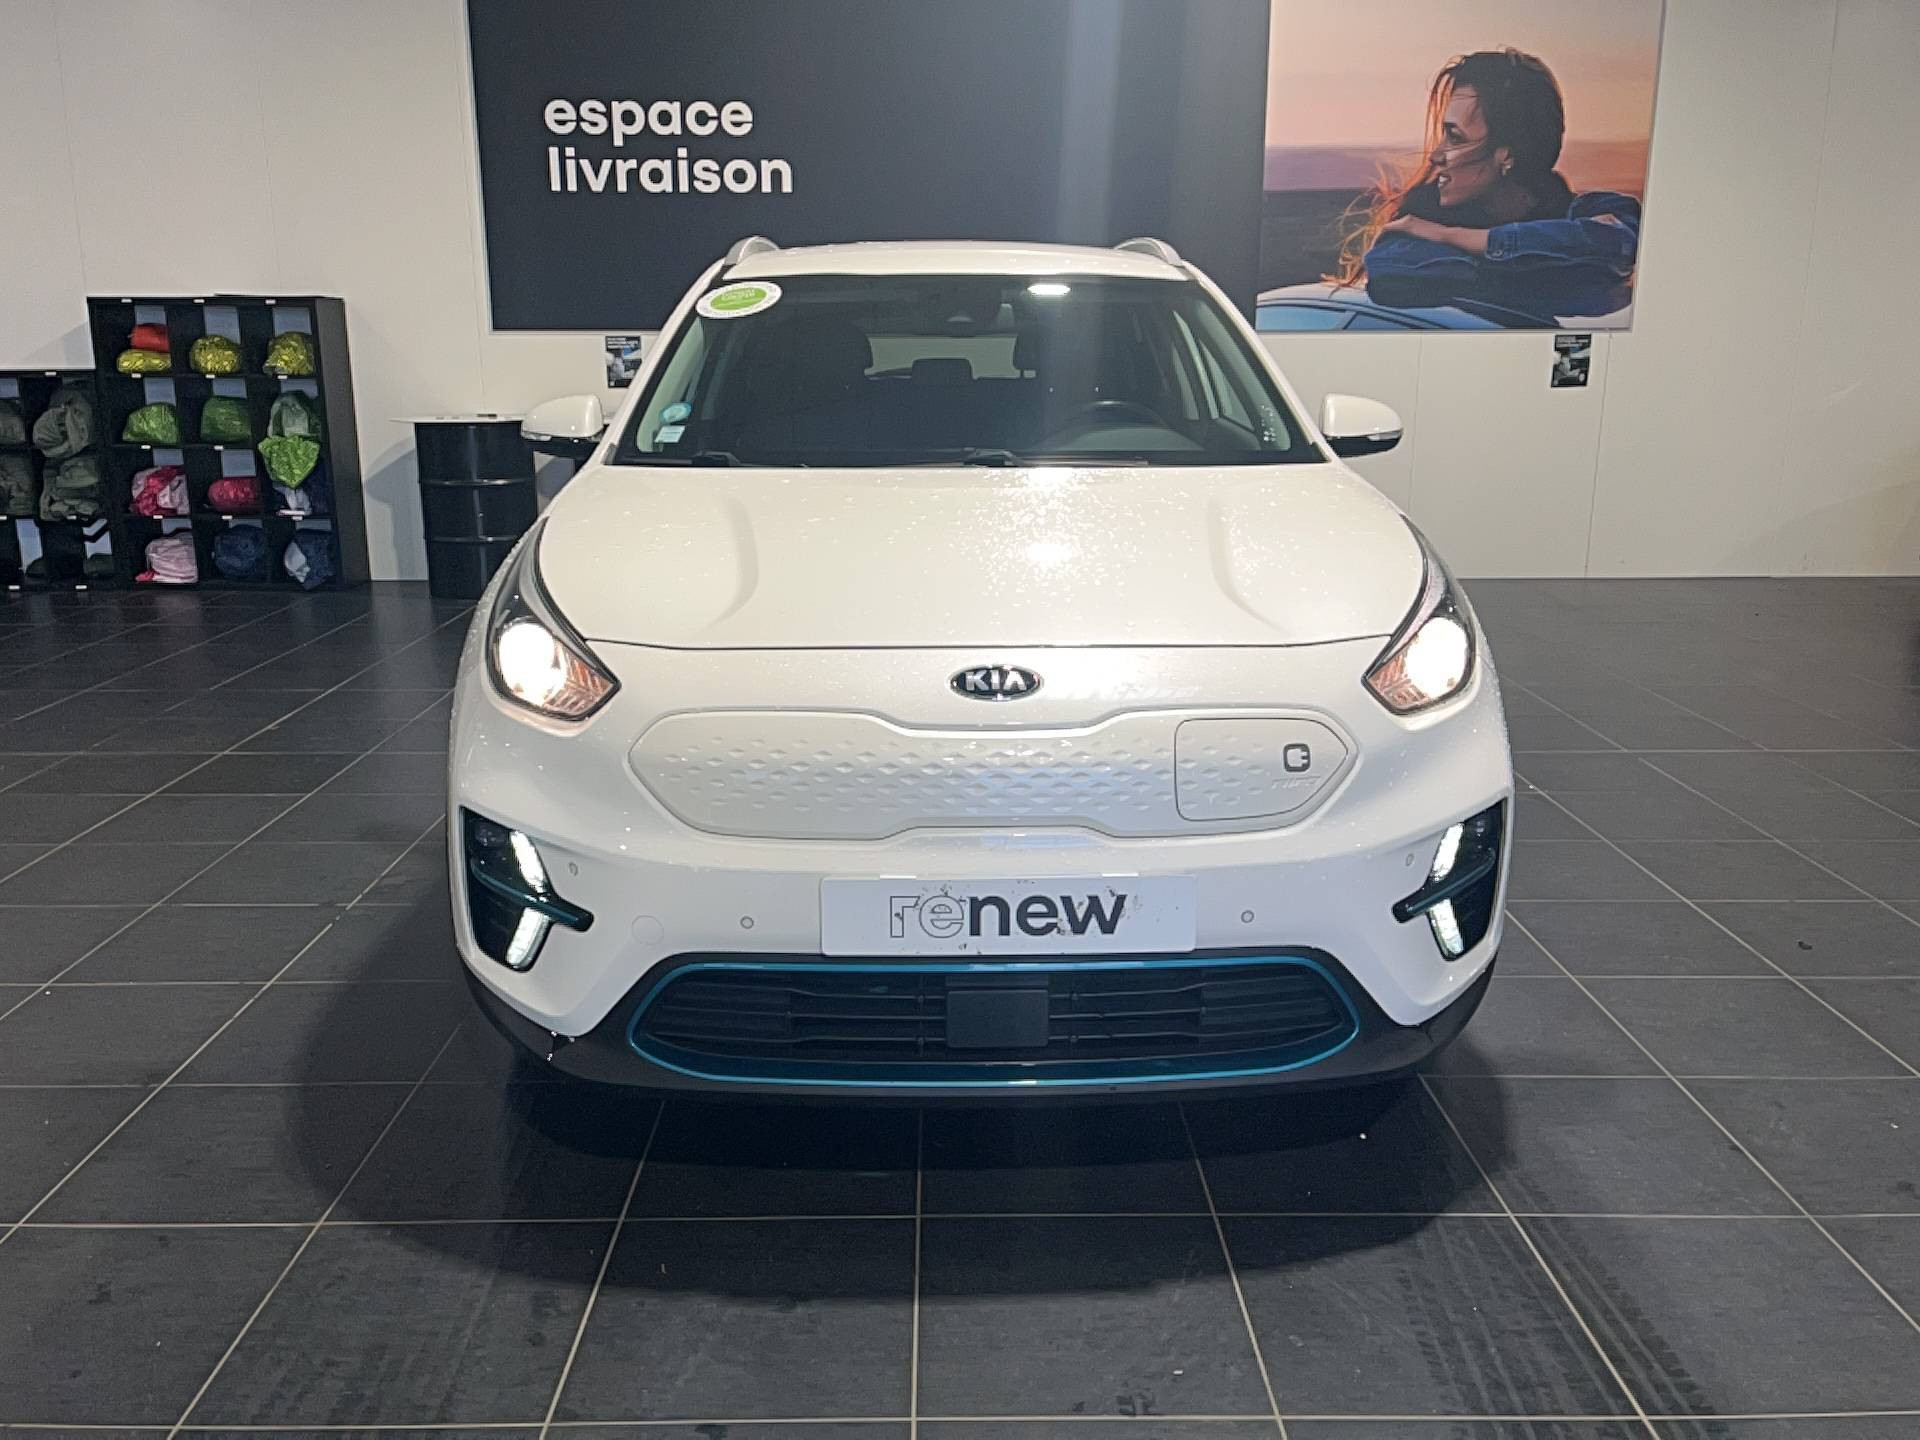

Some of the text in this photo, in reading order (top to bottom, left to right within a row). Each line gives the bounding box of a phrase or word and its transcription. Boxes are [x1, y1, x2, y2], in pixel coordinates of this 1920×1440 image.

[544, 99, 753, 147] espace
[548, 146, 793, 193] livraison
[964, 669, 1027, 691] KIA
[889, 893, 1128, 938] renew
